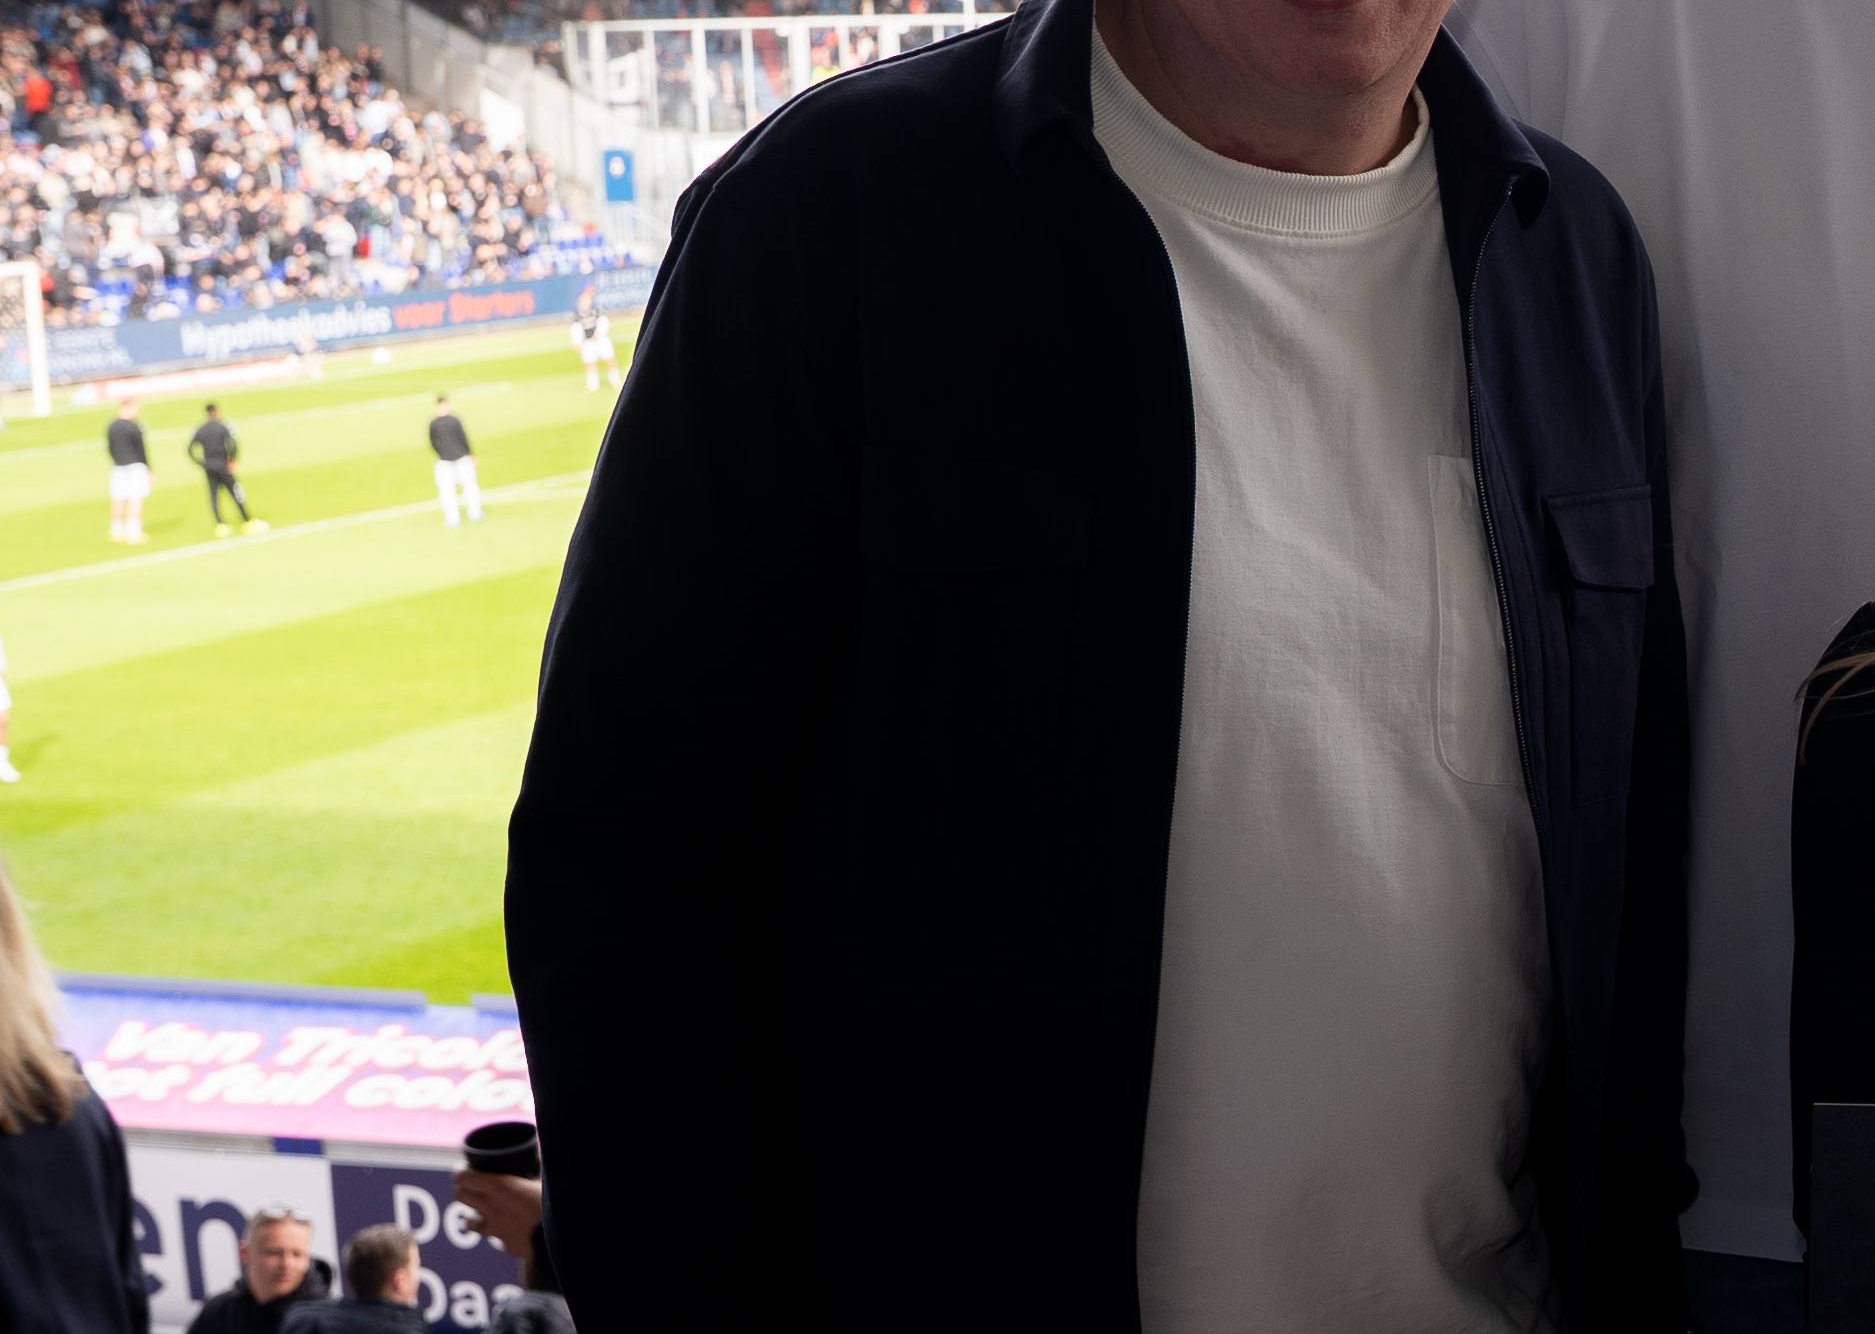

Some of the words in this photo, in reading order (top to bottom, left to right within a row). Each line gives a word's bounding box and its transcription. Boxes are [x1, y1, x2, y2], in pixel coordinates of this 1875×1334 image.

[180, 302, 392, 360] Hypotheekadvies
[394, 301, 445, 330] voor
[450, 290, 534, 323] Starters
[104, 1019, 265, 1065] Van
[186, 1061, 356, 1107] full
